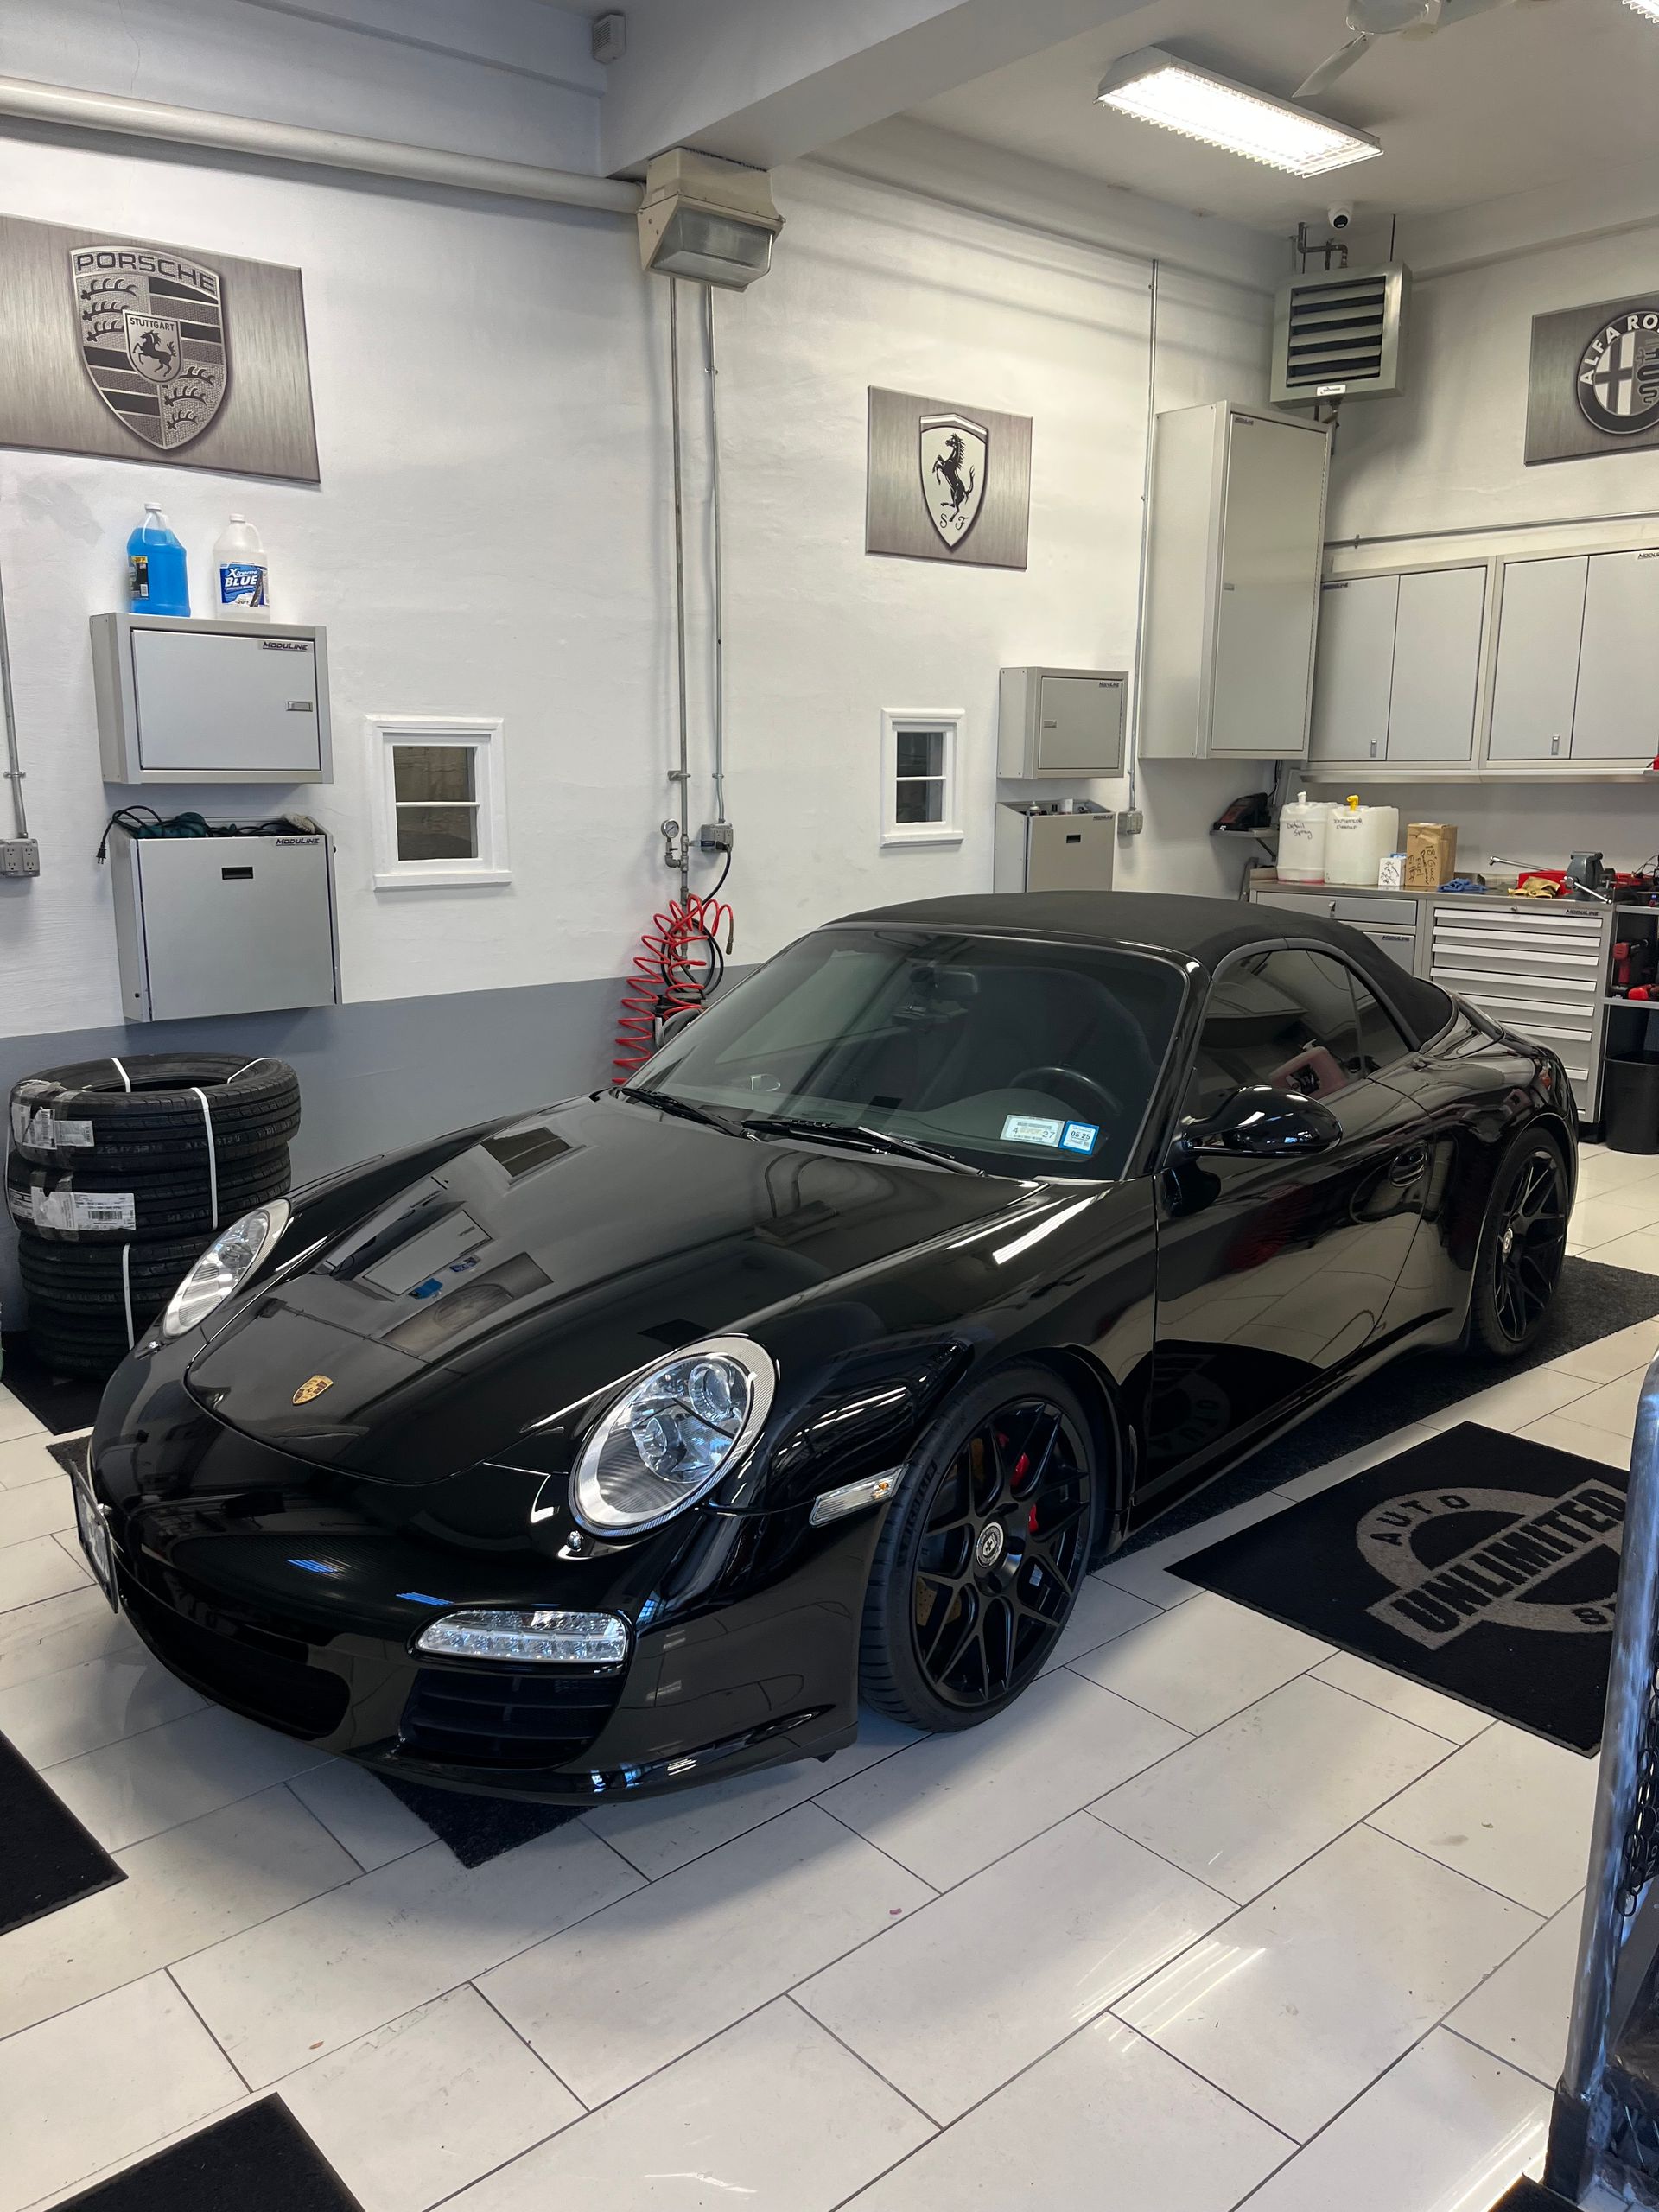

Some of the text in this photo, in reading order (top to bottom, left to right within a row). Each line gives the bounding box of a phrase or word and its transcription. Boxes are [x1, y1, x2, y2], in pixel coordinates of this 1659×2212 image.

[77, 252, 217, 295] PORSCHE
[130, 317, 175, 332] STUTTGART
[1580, 314, 1659, 385] ALFA RO
[940, 513, 948, 528] S
[225, 575, 258, 588] BLUE
[262, 641, 308, 651] MODULINE
[1286, 821, 1306, 830] Detail
[275, 837, 321, 846] MODULINE
[1042, 1130, 1056, 1139] 27
[1370, 1494, 1471, 1547] AUTO
[1389, 1488, 1627, 1634] UNLIMITED
